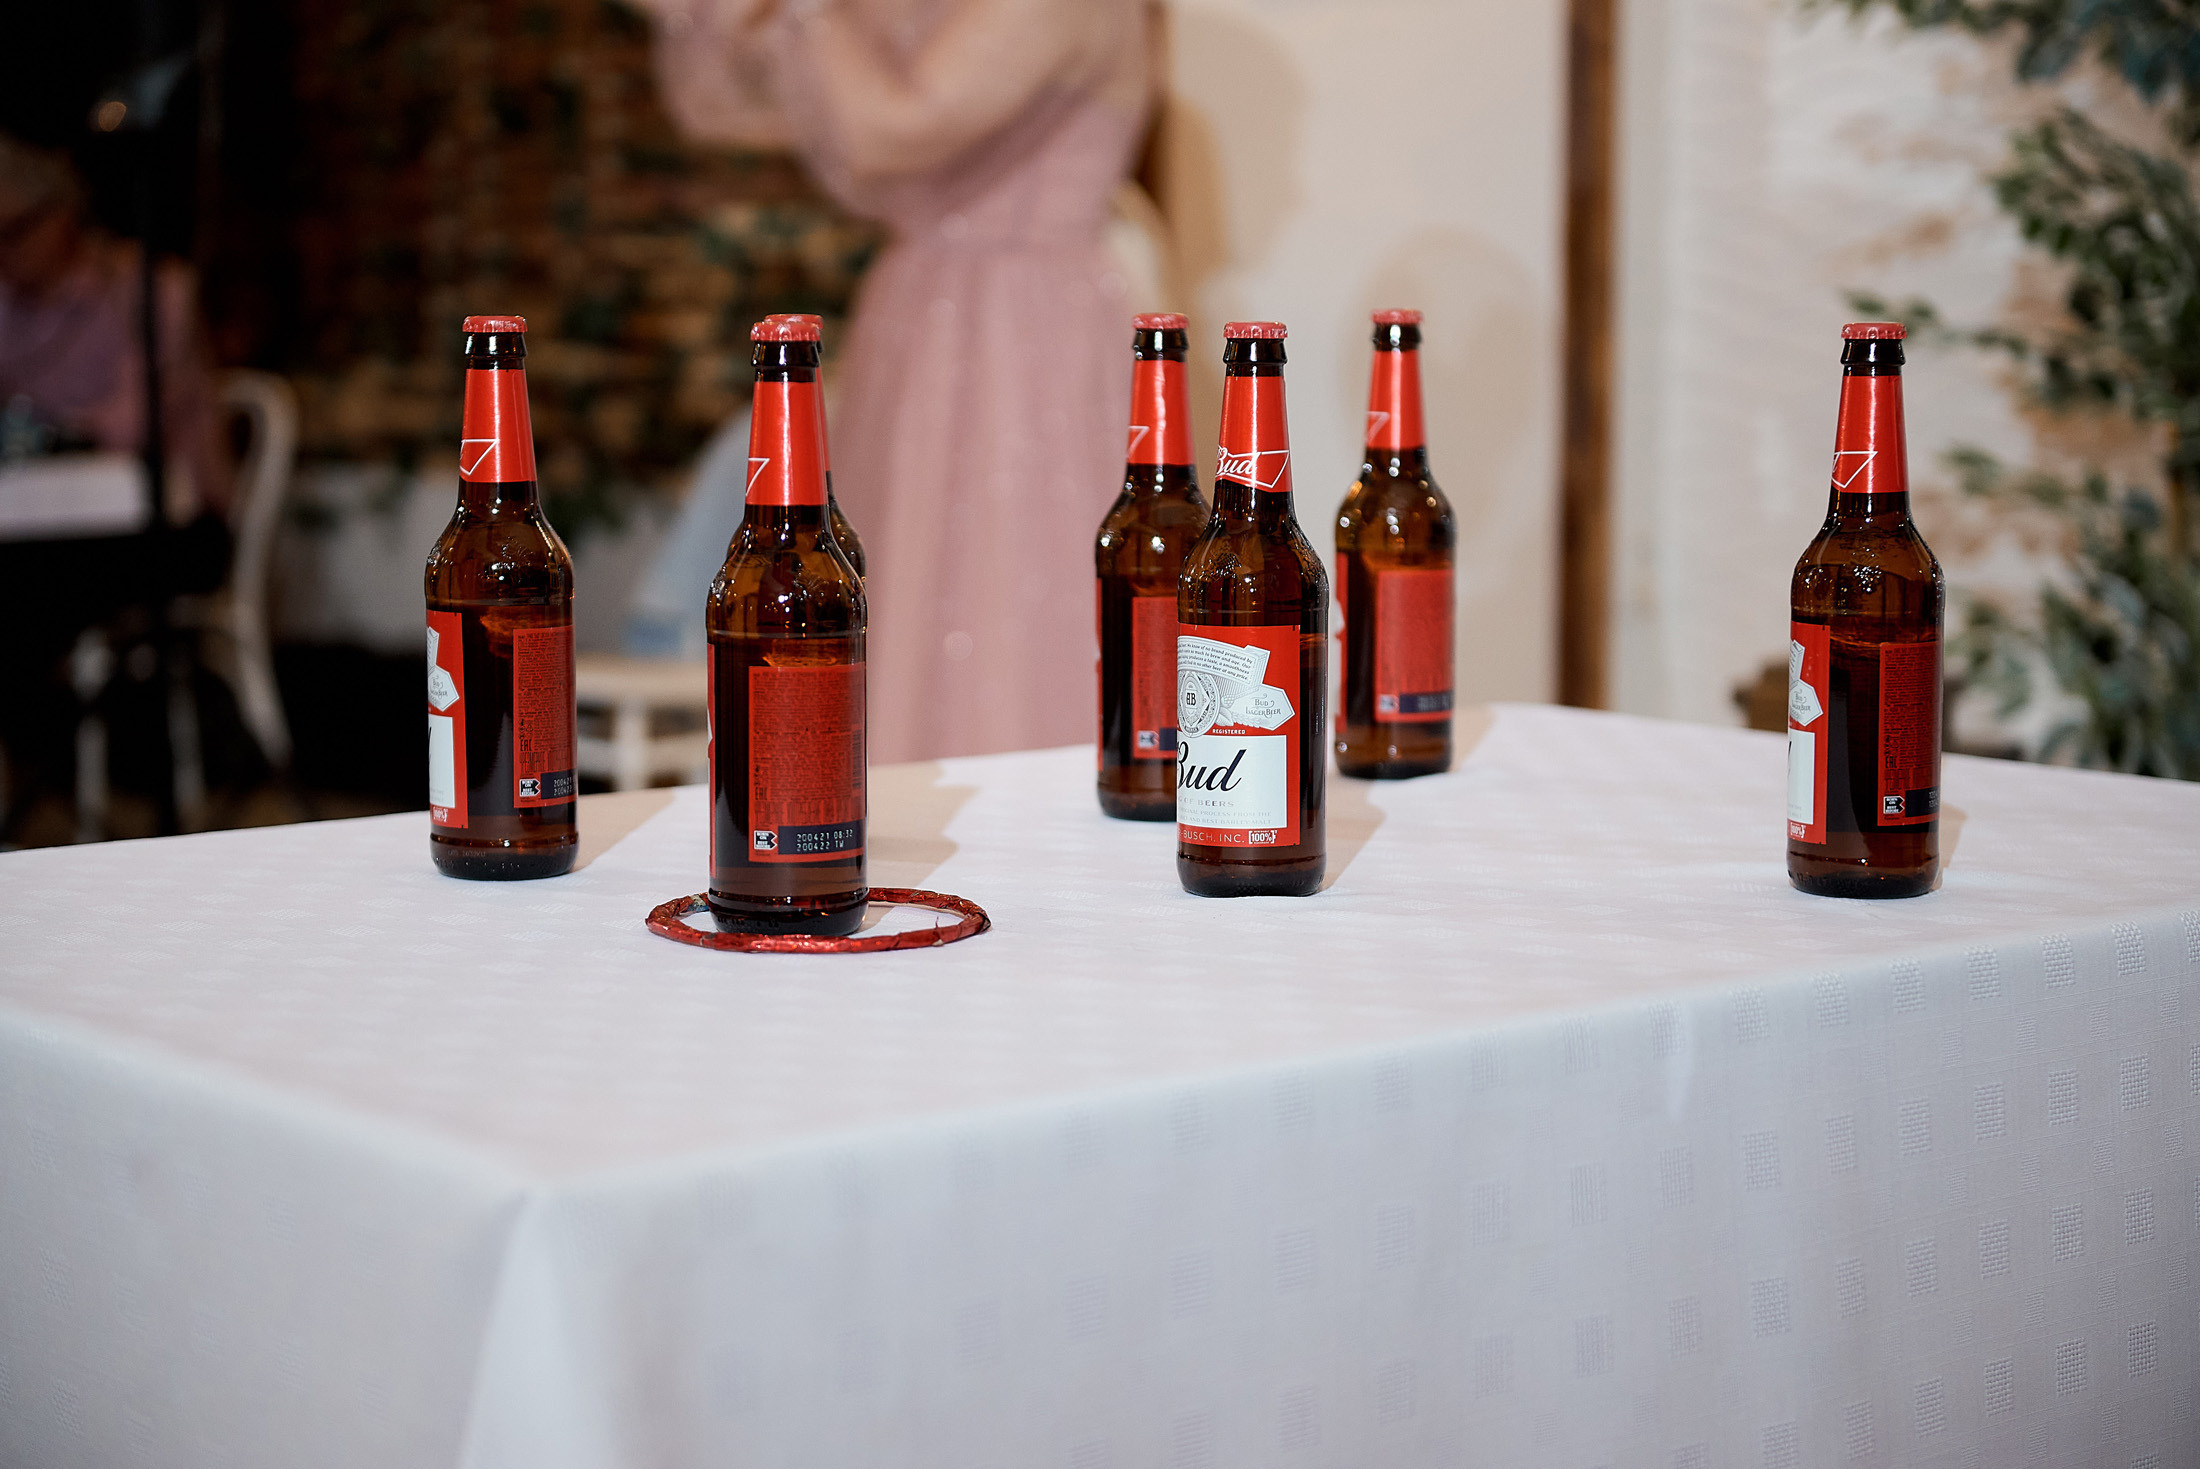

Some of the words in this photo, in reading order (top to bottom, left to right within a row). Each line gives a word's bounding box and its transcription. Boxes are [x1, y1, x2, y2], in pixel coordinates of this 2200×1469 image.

[1216, 445, 1261, 475] Bud
[1211, 647, 1225, 655] brand
[1224, 651, 1247, 662] produced
[1246, 657, 1253, 665] by
[1223, 663, 1250, 675] smoothness
[1177, 740, 1247, 792] Bud
[1198, 800, 1234, 808] BEERS
[797, 832, 830, 843] 200421
[1219, 833, 1245, 844] INC.
[1251, 832, 1273, 842] 100%
[796, 841, 830, 852] 200422
